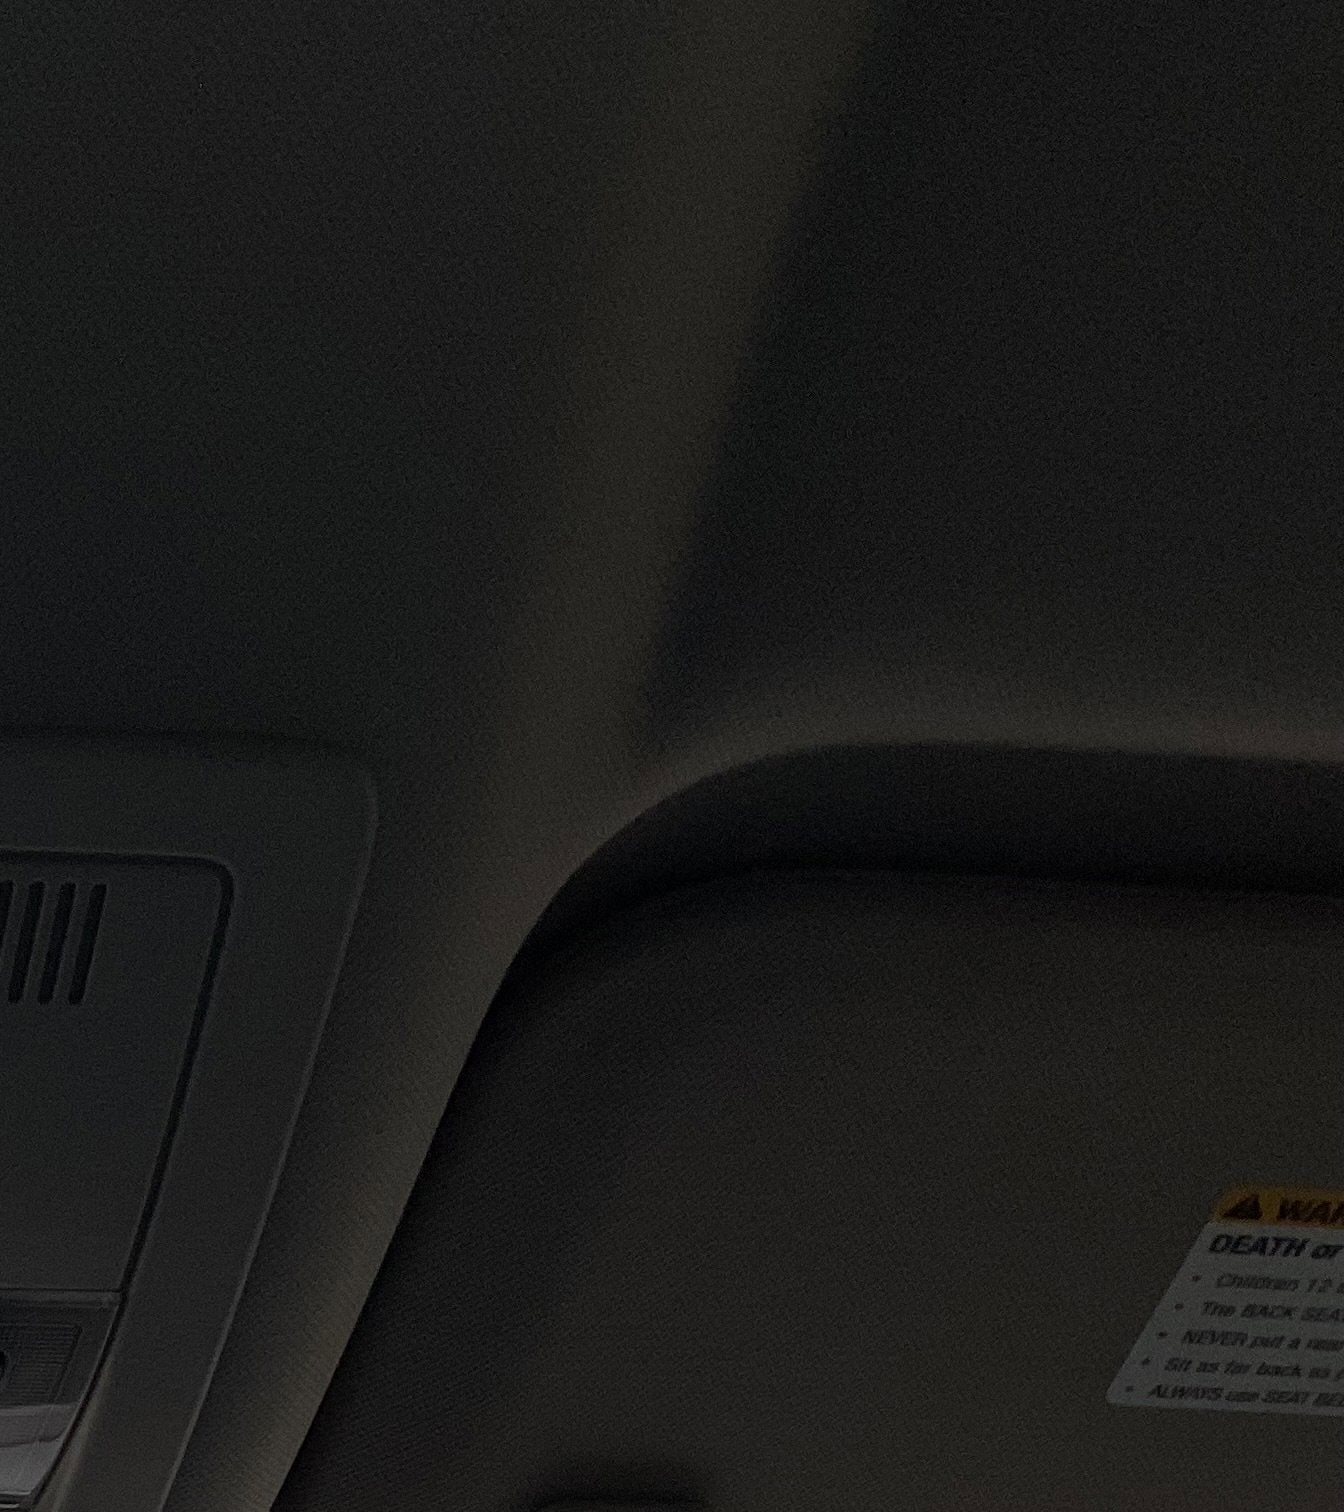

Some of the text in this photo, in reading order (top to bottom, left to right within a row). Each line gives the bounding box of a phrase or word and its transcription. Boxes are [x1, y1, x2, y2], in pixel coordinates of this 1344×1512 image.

[1209, 1234, 1344, 1260] DEATH or
[1240, 1304, 1298, 1321] BACK
[1301, 1307, 1344, 1323] SEA
[1181, 1331, 1248, 1348] NEVER
[1256, 1361, 1302, 1378] back
[1148, 1384, 1224, 1401] ALWAYS
